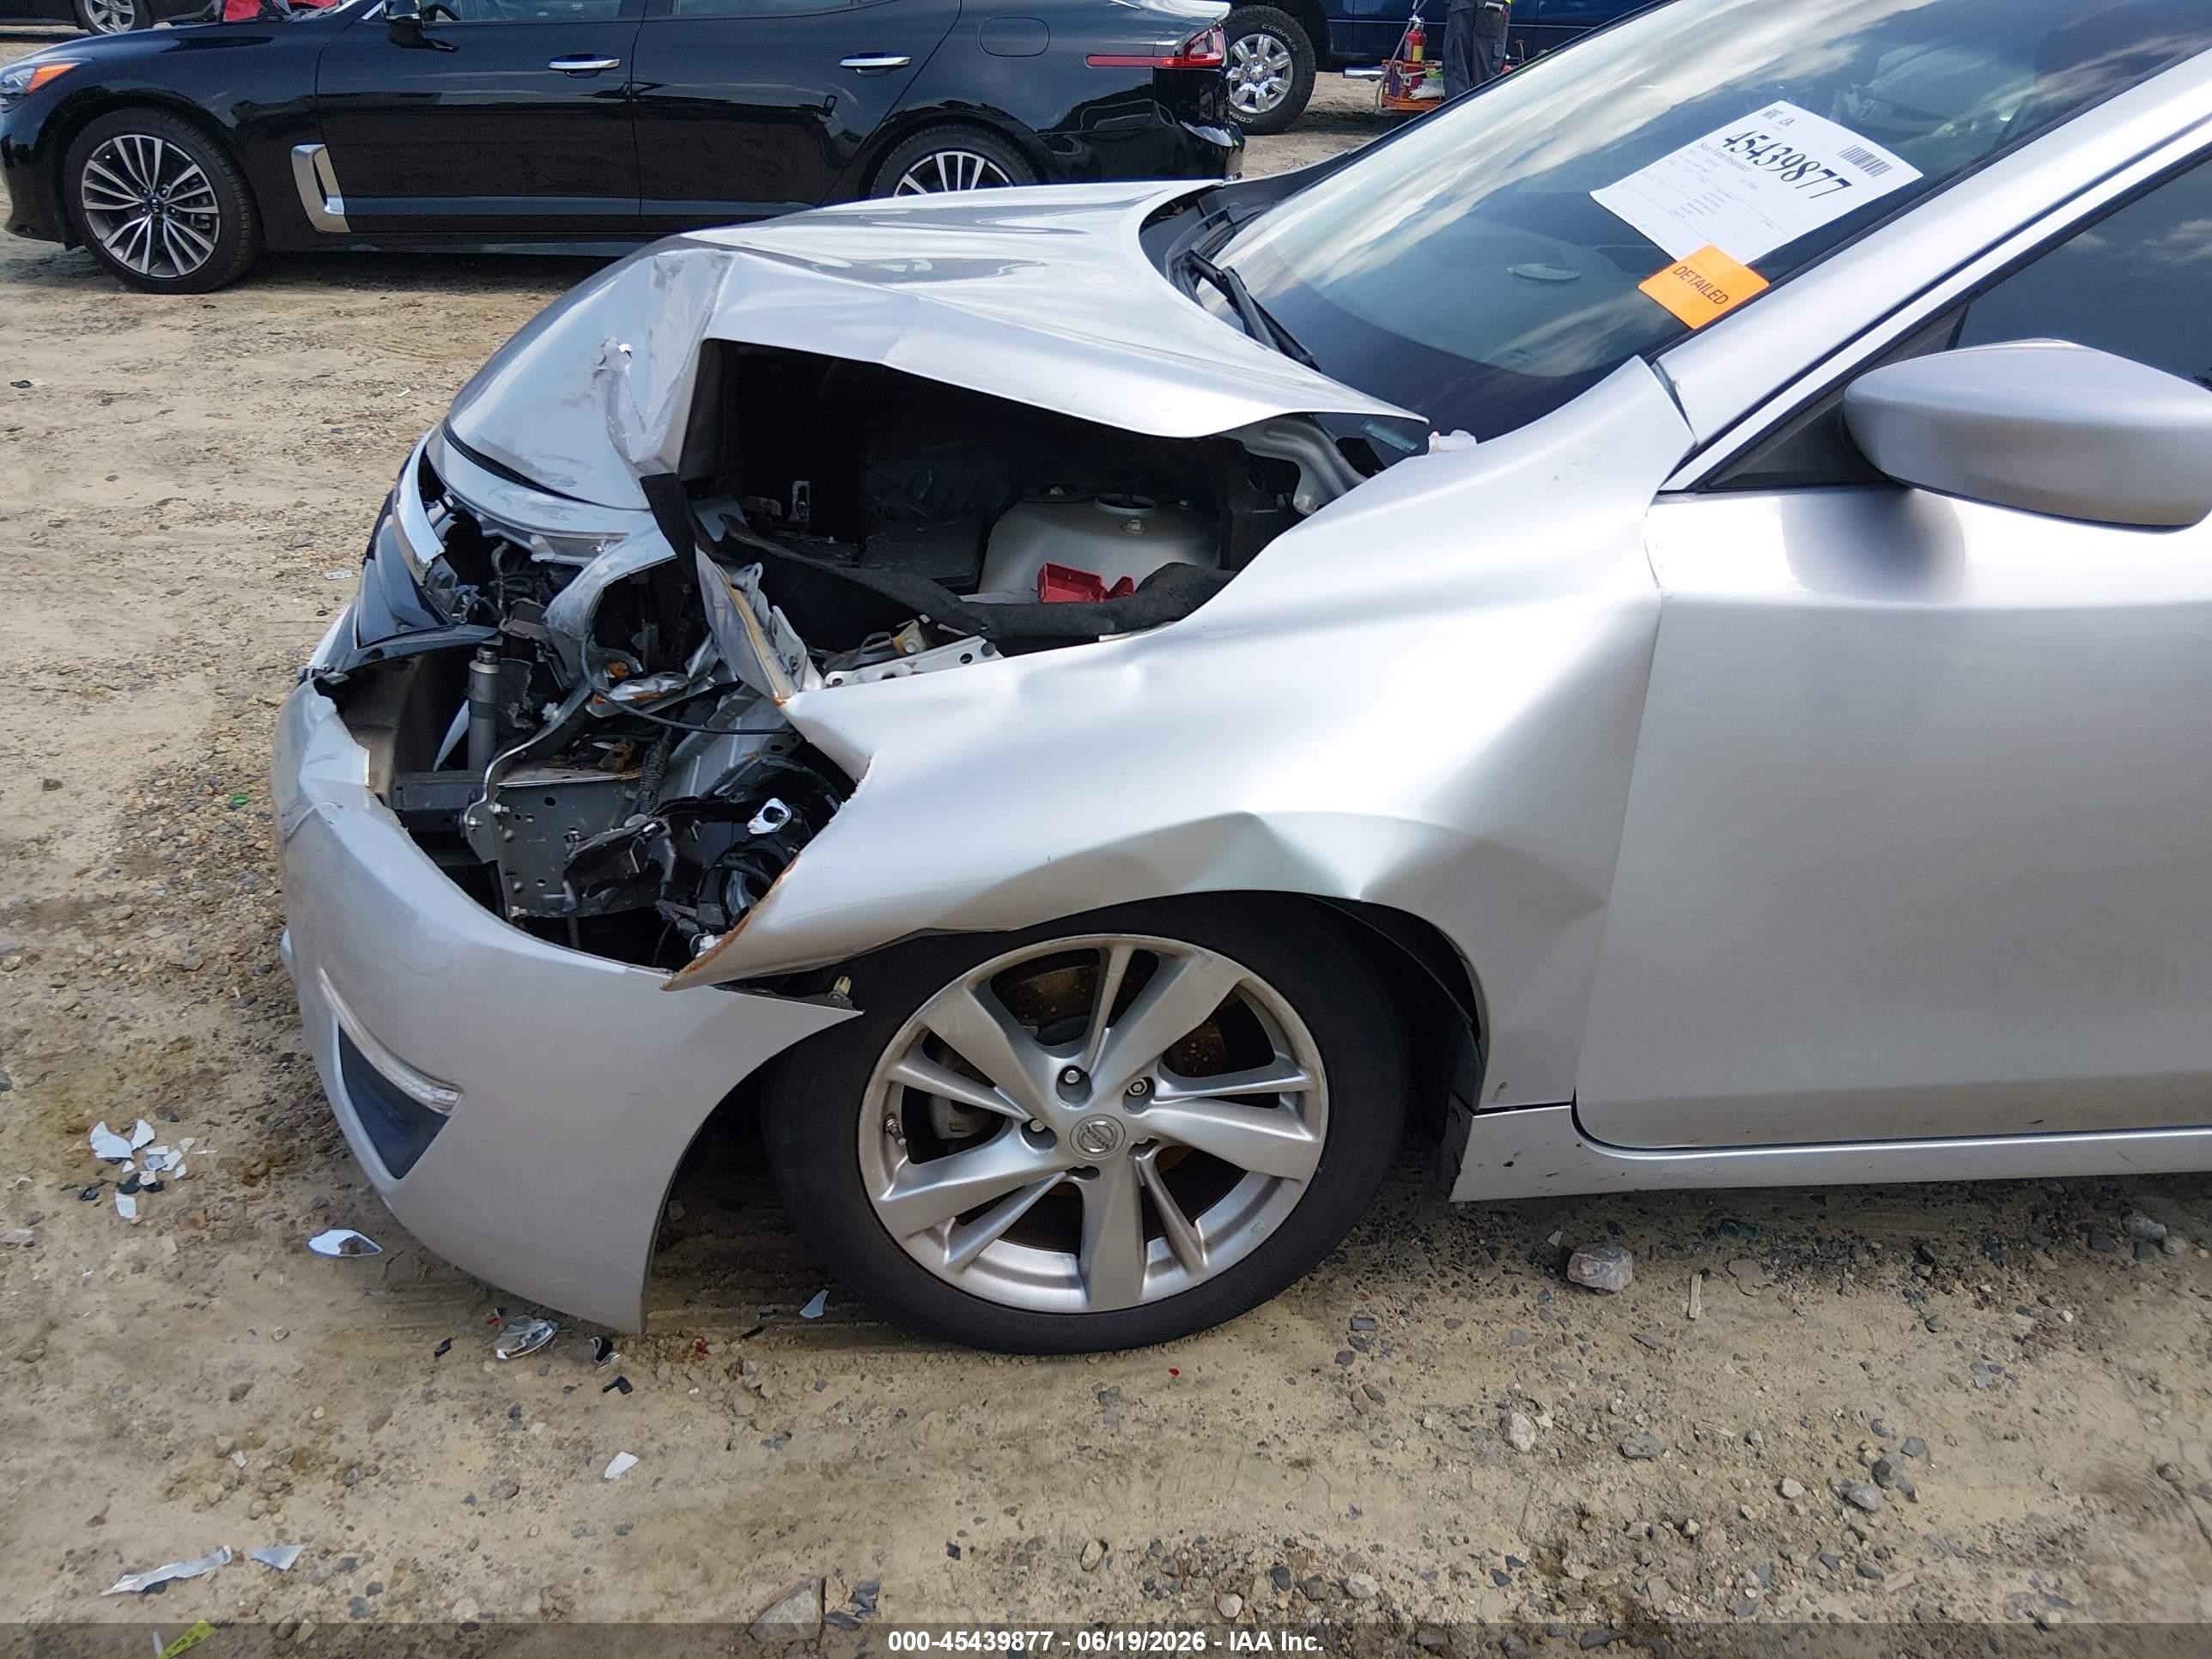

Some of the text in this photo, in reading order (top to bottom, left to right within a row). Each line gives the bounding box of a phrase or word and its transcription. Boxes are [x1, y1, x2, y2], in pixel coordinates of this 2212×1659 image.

[1261, 23, 1297, 52] COOPER
[1721, 130, 1853, 199] 45439877
[151, 199, 160, 213] KIA
[1673, 265, 1729, 305] DETAILED
[1085, 1126, 1111, 1150] NISSAN
